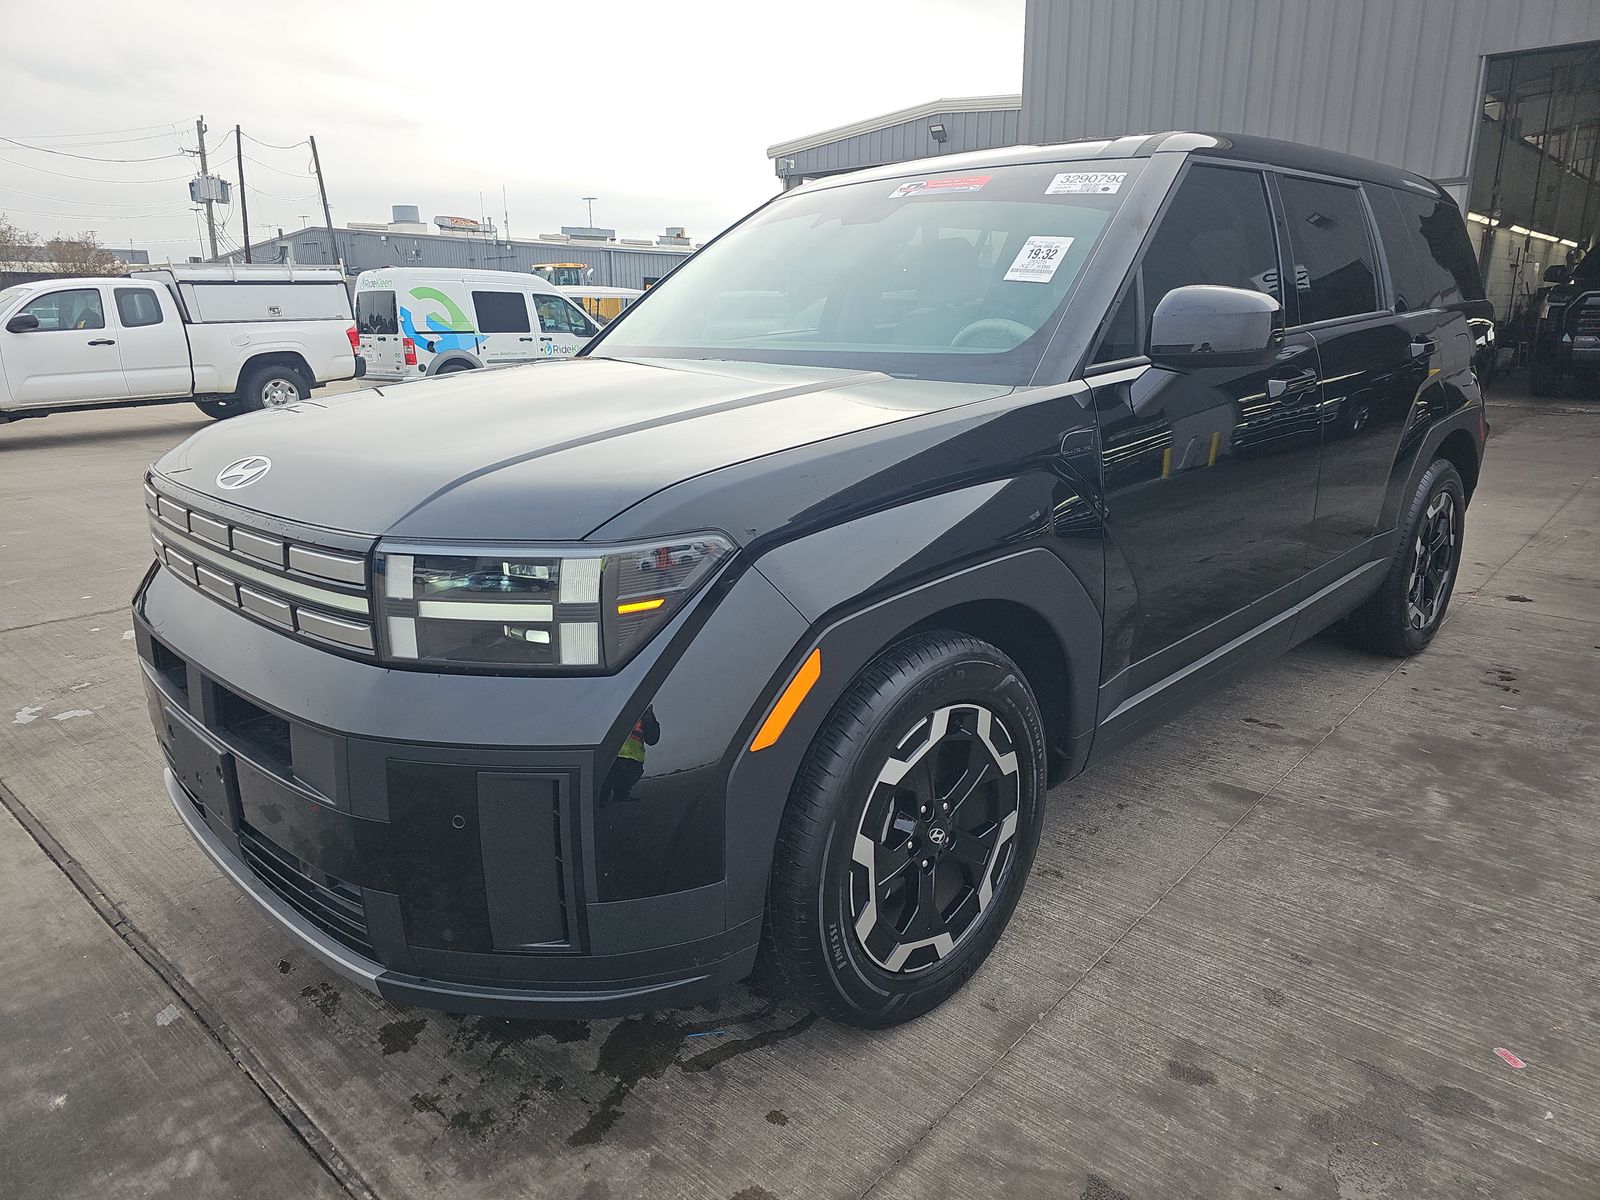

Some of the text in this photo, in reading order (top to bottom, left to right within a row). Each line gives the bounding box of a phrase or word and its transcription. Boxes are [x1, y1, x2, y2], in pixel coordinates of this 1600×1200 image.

[1060, 174, 1125, 183] 3290790
[1027, 248, 1058, 260] 19:32
[829, 921, 847, 970] FINESSE
